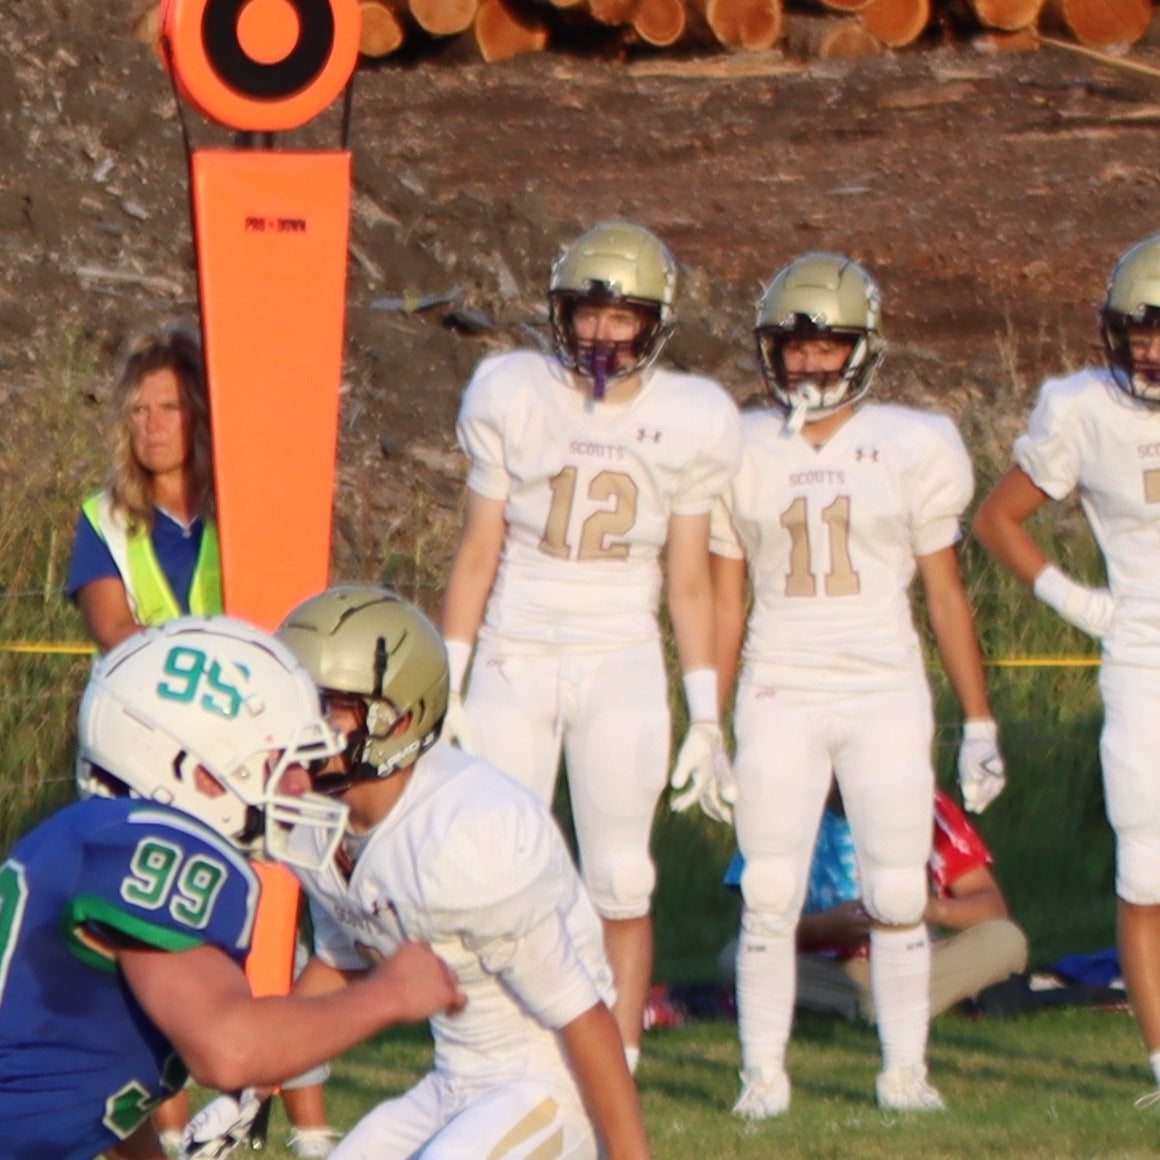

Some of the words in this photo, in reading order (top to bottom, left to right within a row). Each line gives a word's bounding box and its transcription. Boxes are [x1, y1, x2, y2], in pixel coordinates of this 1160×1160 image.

[568, 440, 625, 460] SCOUTS
[788, 468, 846, 486] SCOUTS
[538, 464, 639, 562] 12
[779, 494, 861, 597] 11
[120, 836, 227, 929] 99
